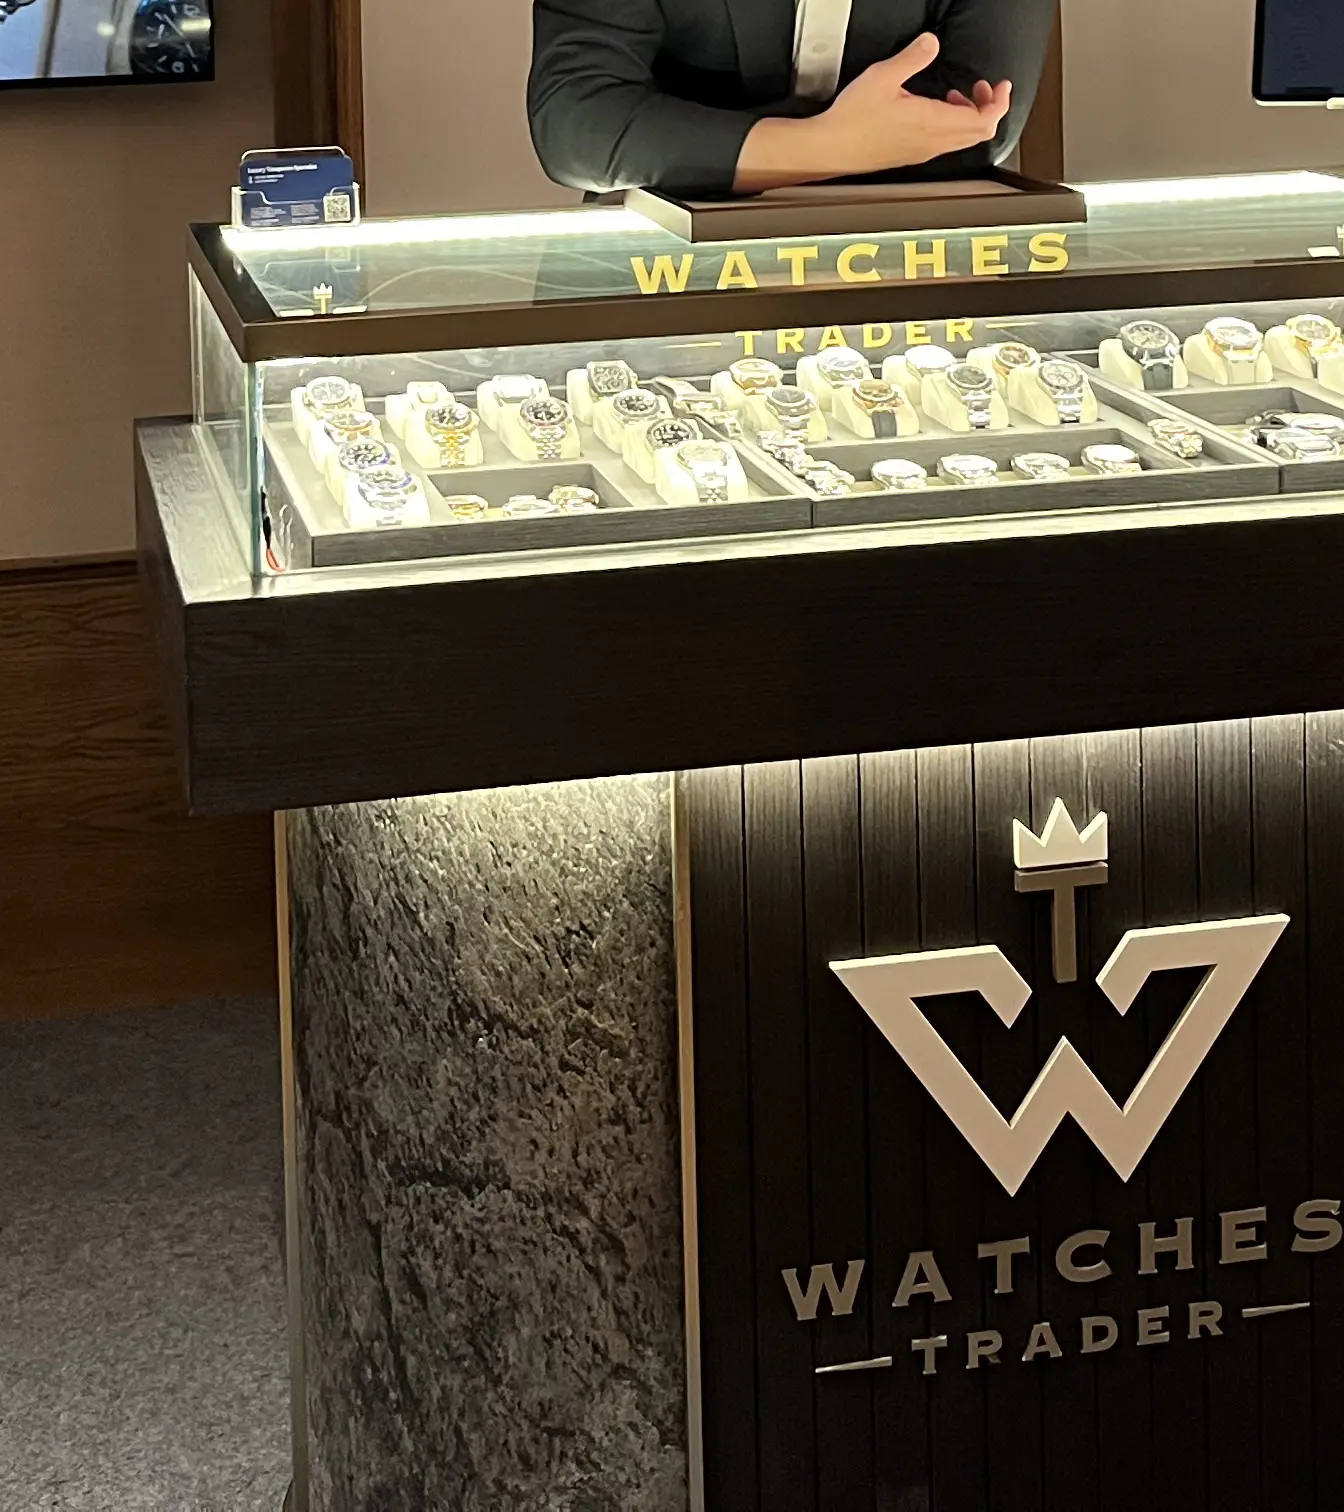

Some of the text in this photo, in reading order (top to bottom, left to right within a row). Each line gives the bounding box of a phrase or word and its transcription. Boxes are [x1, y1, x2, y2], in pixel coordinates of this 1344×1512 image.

[630, 232, 1070, 295] WATCHES
[735, 318, 975, 355] TRADER
[781, 1198, 1344, 1321] WATCHES
[911, 1300, 1224, 1375] TRADER
